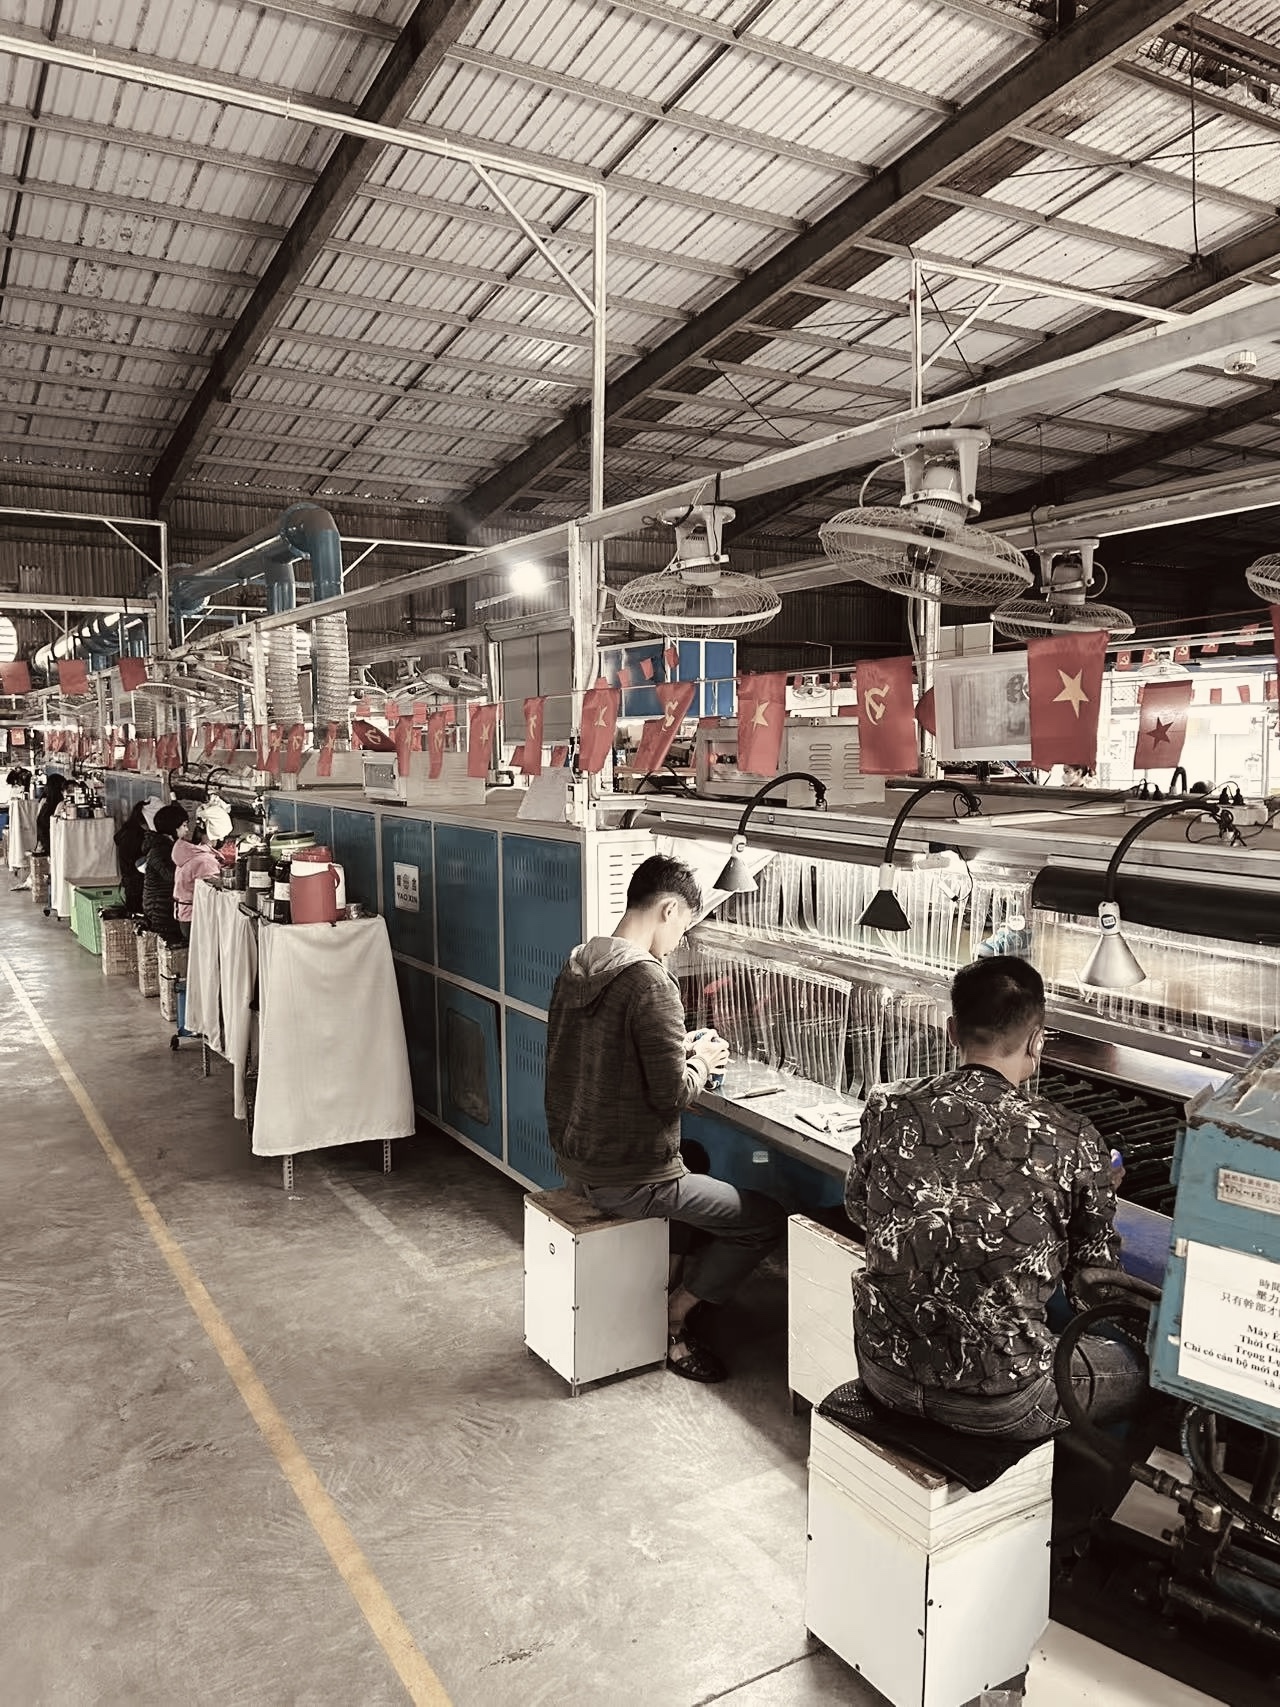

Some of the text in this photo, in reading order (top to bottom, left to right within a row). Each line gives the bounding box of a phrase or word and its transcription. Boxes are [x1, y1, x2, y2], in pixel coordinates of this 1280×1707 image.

[397, 892, 408, 900] YAO
[1247, 1324, 1269, 1339] Máy
[1236, 1357, 1248, 1369] bộ
